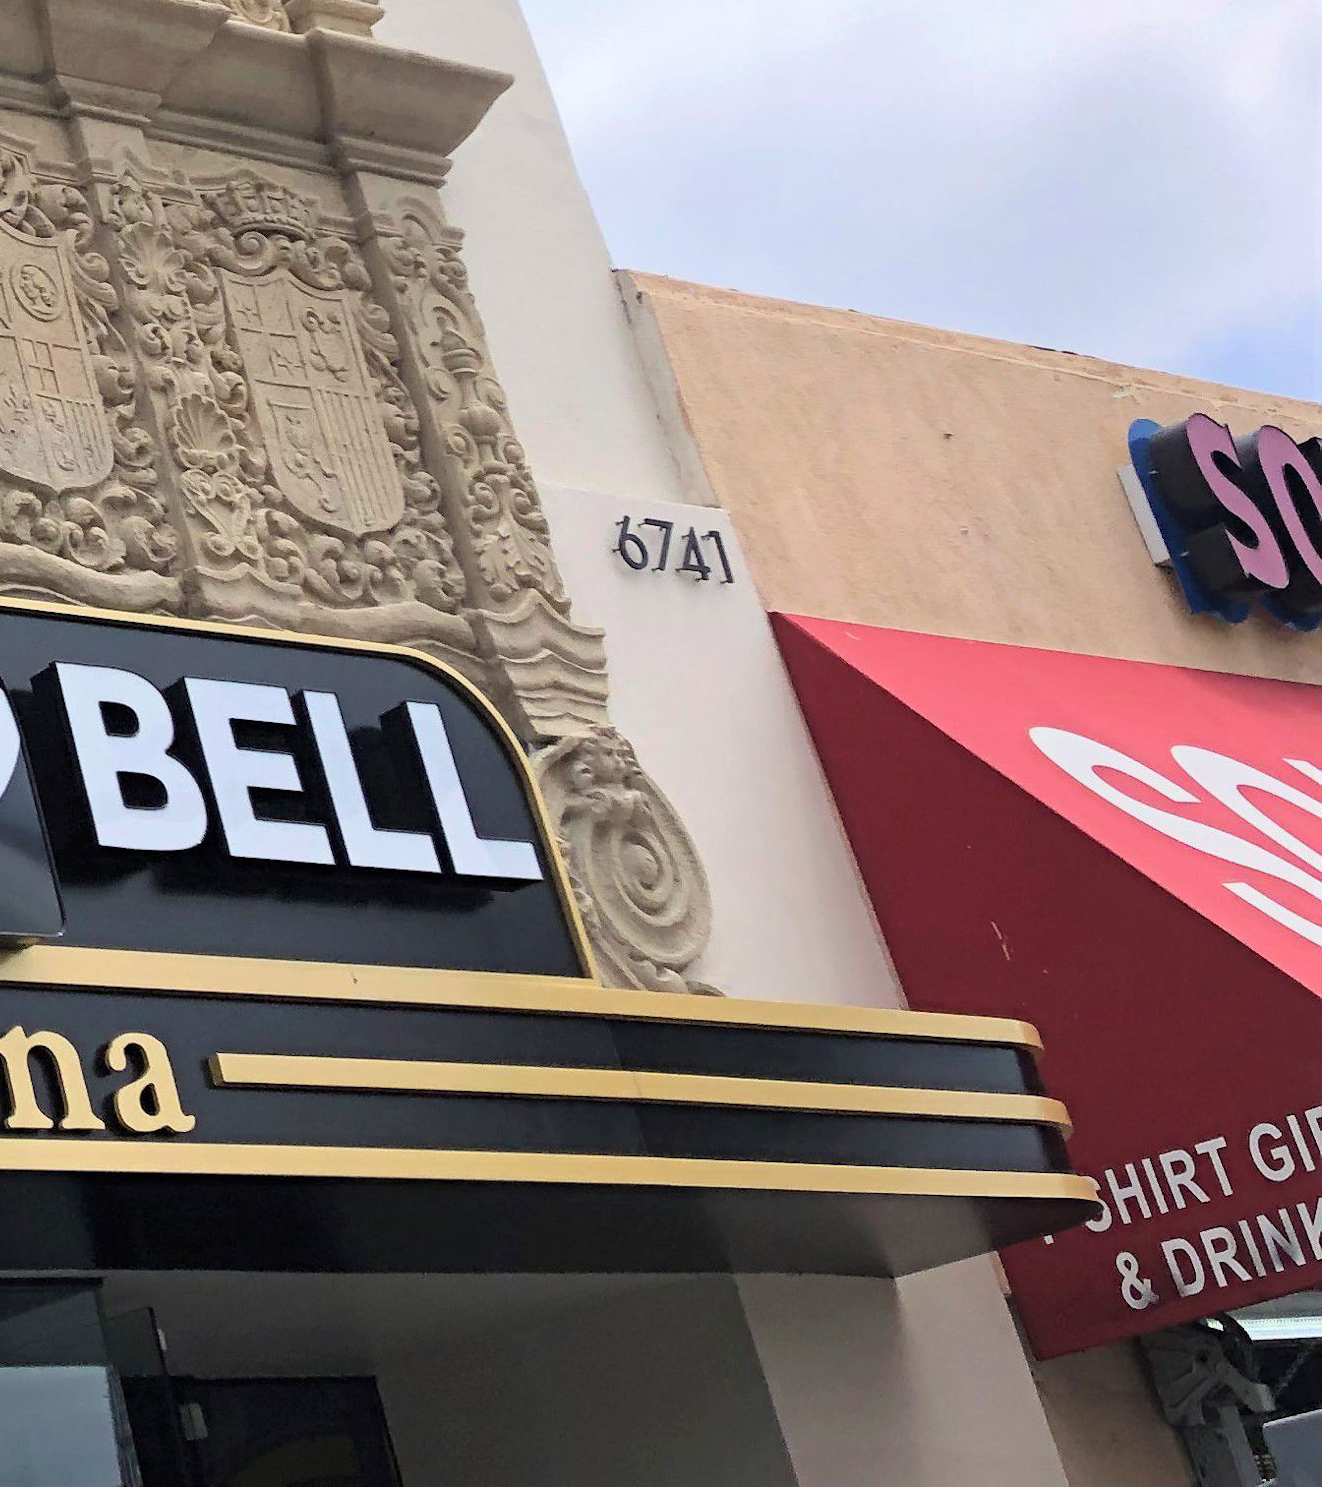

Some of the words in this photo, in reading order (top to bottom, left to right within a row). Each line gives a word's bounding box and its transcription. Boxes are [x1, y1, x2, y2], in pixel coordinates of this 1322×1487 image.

[616, 514, 734, 584] 6741
[53, 660, 544, 881] BELL
[1115, 1250, 1159, 1310] &
